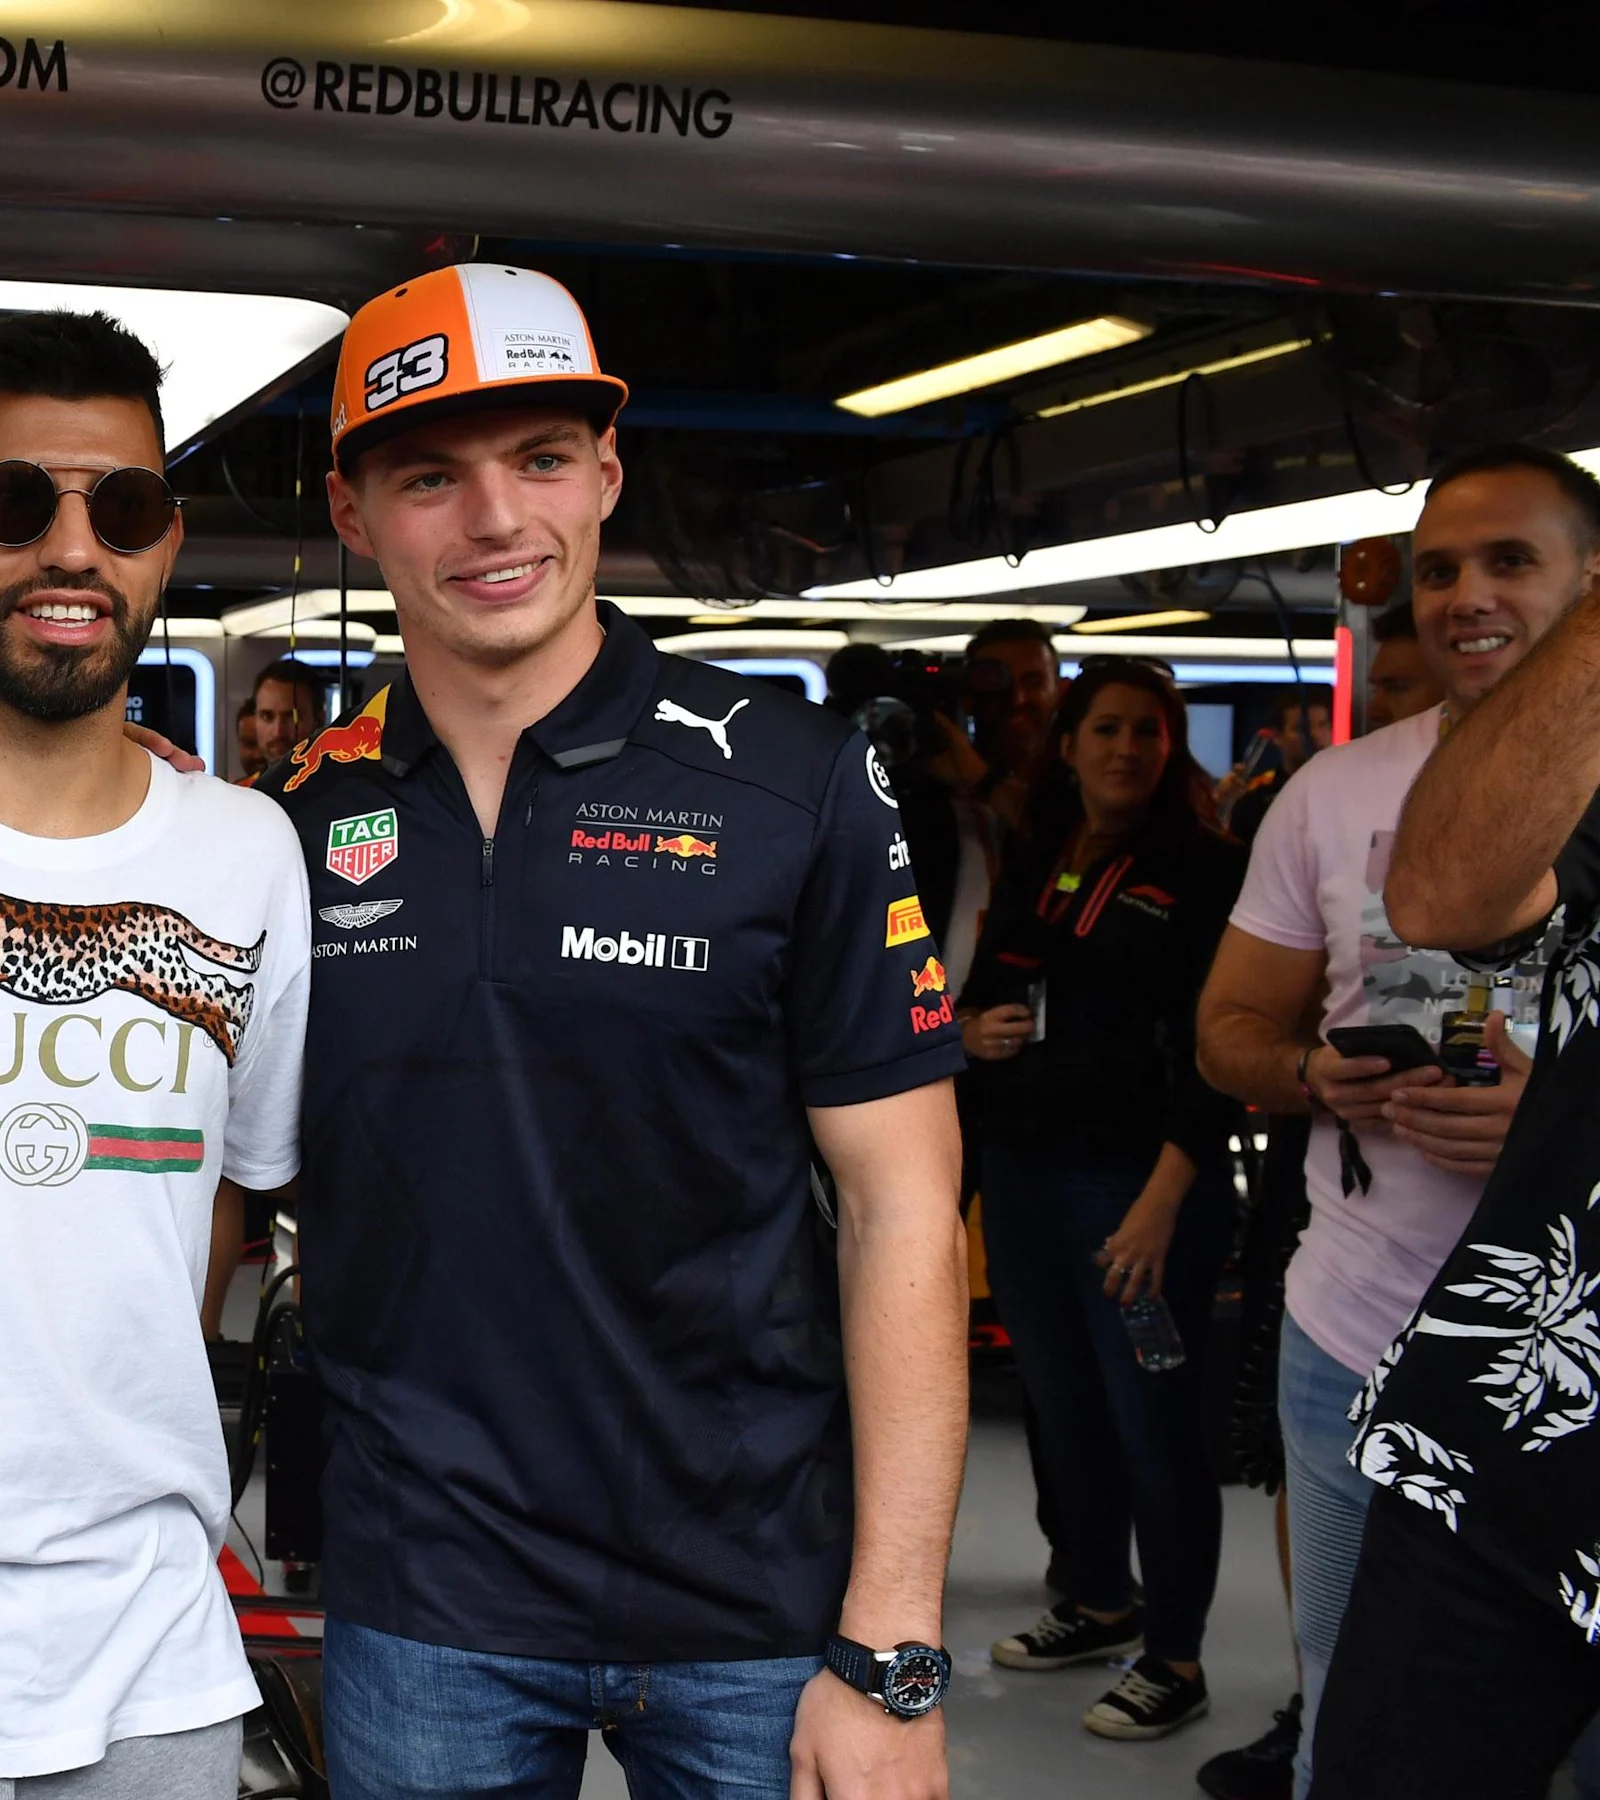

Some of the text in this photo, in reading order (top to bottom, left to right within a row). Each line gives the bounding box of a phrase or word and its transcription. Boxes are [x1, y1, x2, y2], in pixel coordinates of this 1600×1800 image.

[261, 57, 733, 139] @REDBULLRACING
[504, 333, 571, 346] ASTON MARTIN
[506, 349, 546, 359] Red Bull
[366, 335, 447, 411] 33
[508, 361, 576, 373] RACING
[575, 802, 724, 829] ASTON MARTIN
[336, 815, 391, 844] TAG
[571, 829, 652, 852] Red Bull
[332, 842, 393, 879] HEUER
[568, 852, 717, 876] RACING
[353, 935, 417, 955] MARTIN
[561, 926, 666, 967] Mobil
